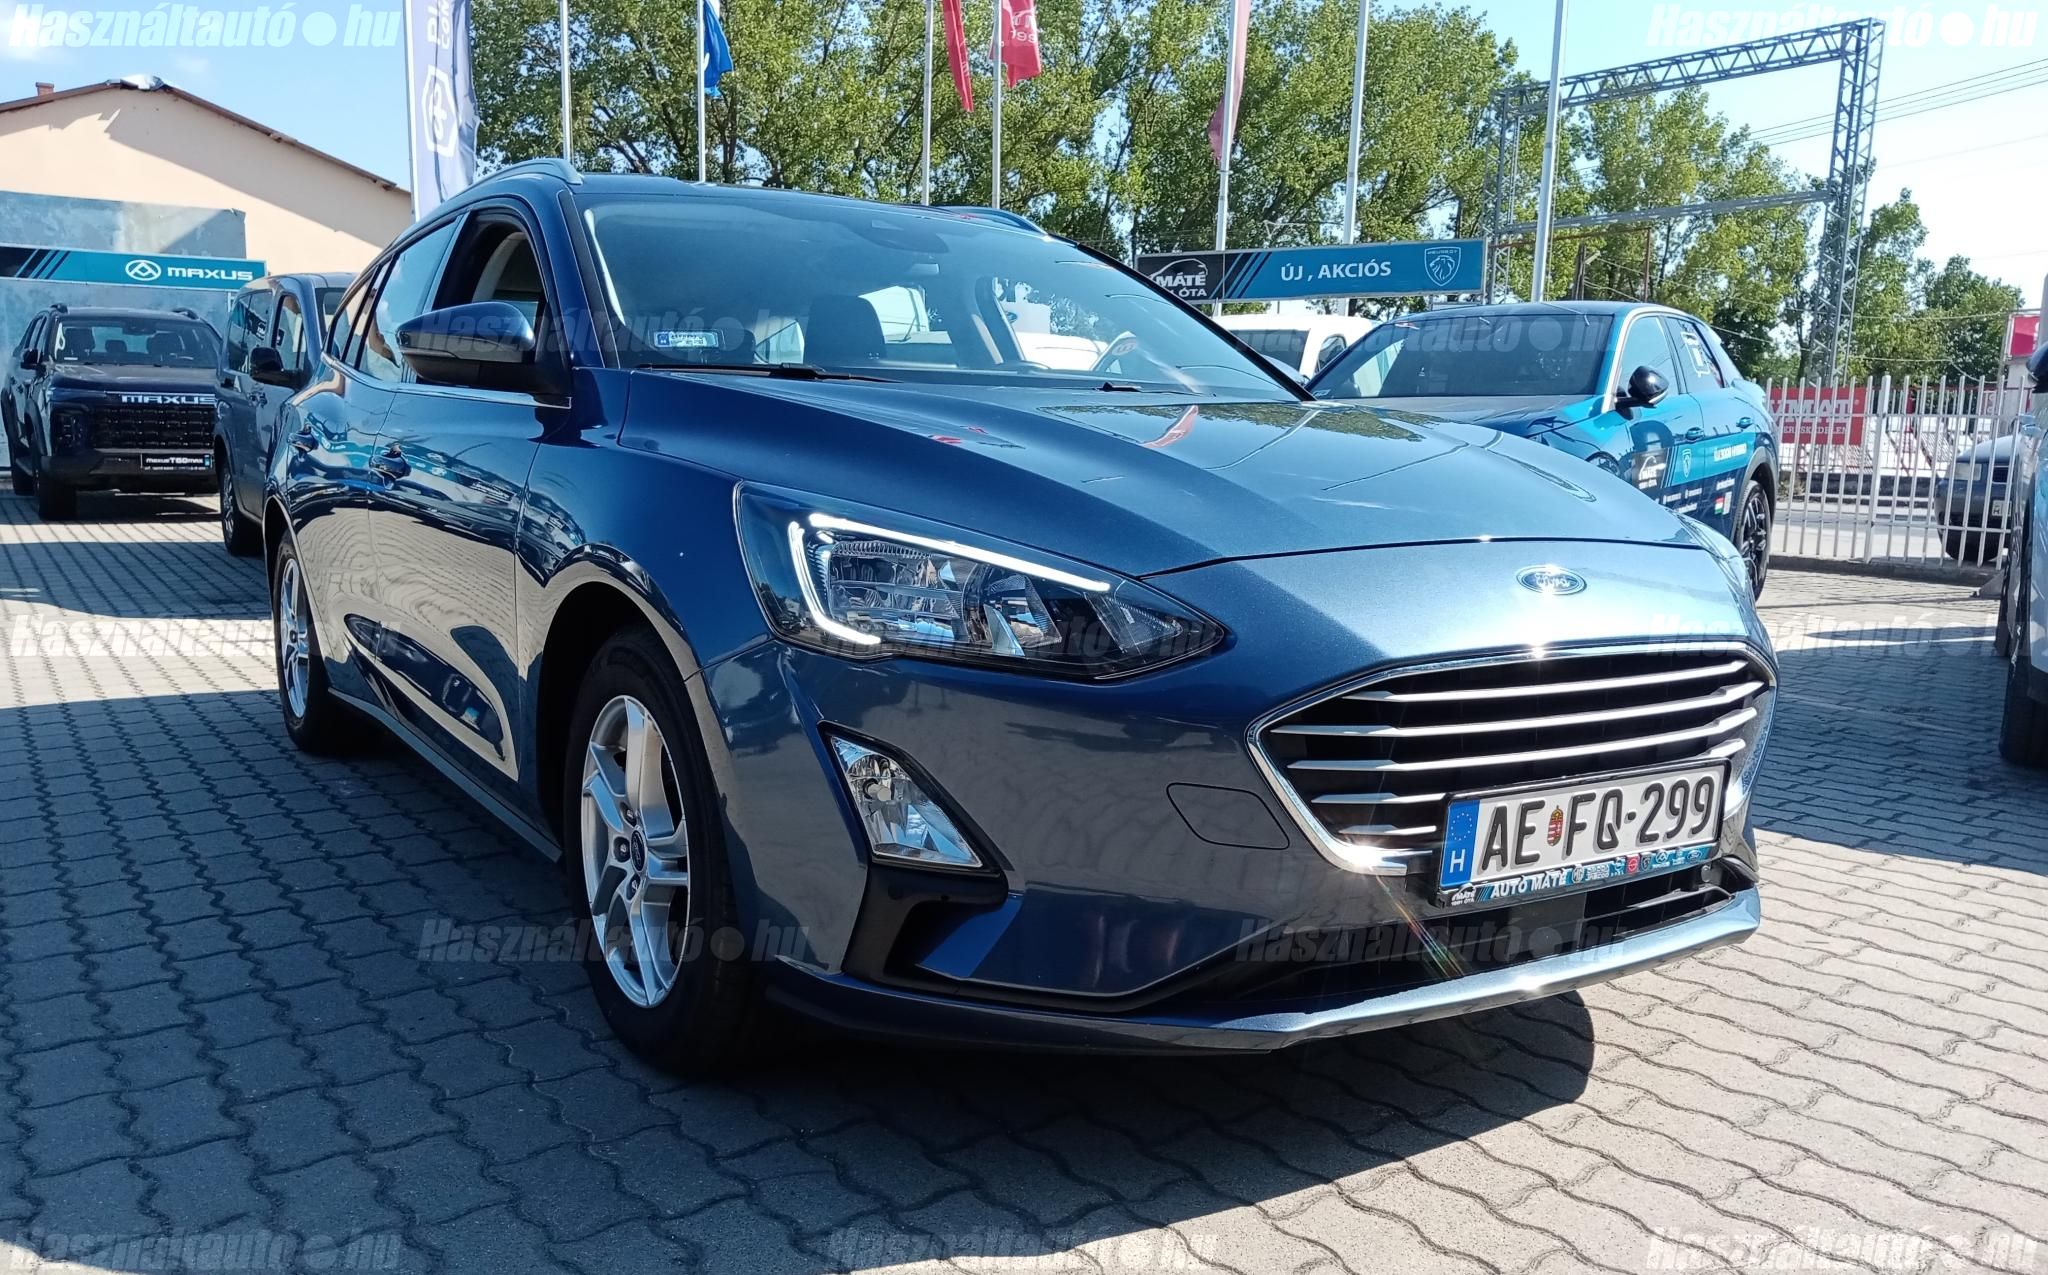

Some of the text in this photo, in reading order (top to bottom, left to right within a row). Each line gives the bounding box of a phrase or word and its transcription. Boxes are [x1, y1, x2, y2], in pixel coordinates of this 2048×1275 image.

[167, 267, 253, 280] MAXUS
[1318, 259, 1392, 278] AKCIÓS
[1155, 272, 1206, 287] MÁTÉ
[1178, 287, 1207, 297] ÓTA
[121, 394, 217, 405] MAXUS
[1481, 800, 1545, 870] AE
[1450, 850, 1464, 873] H
